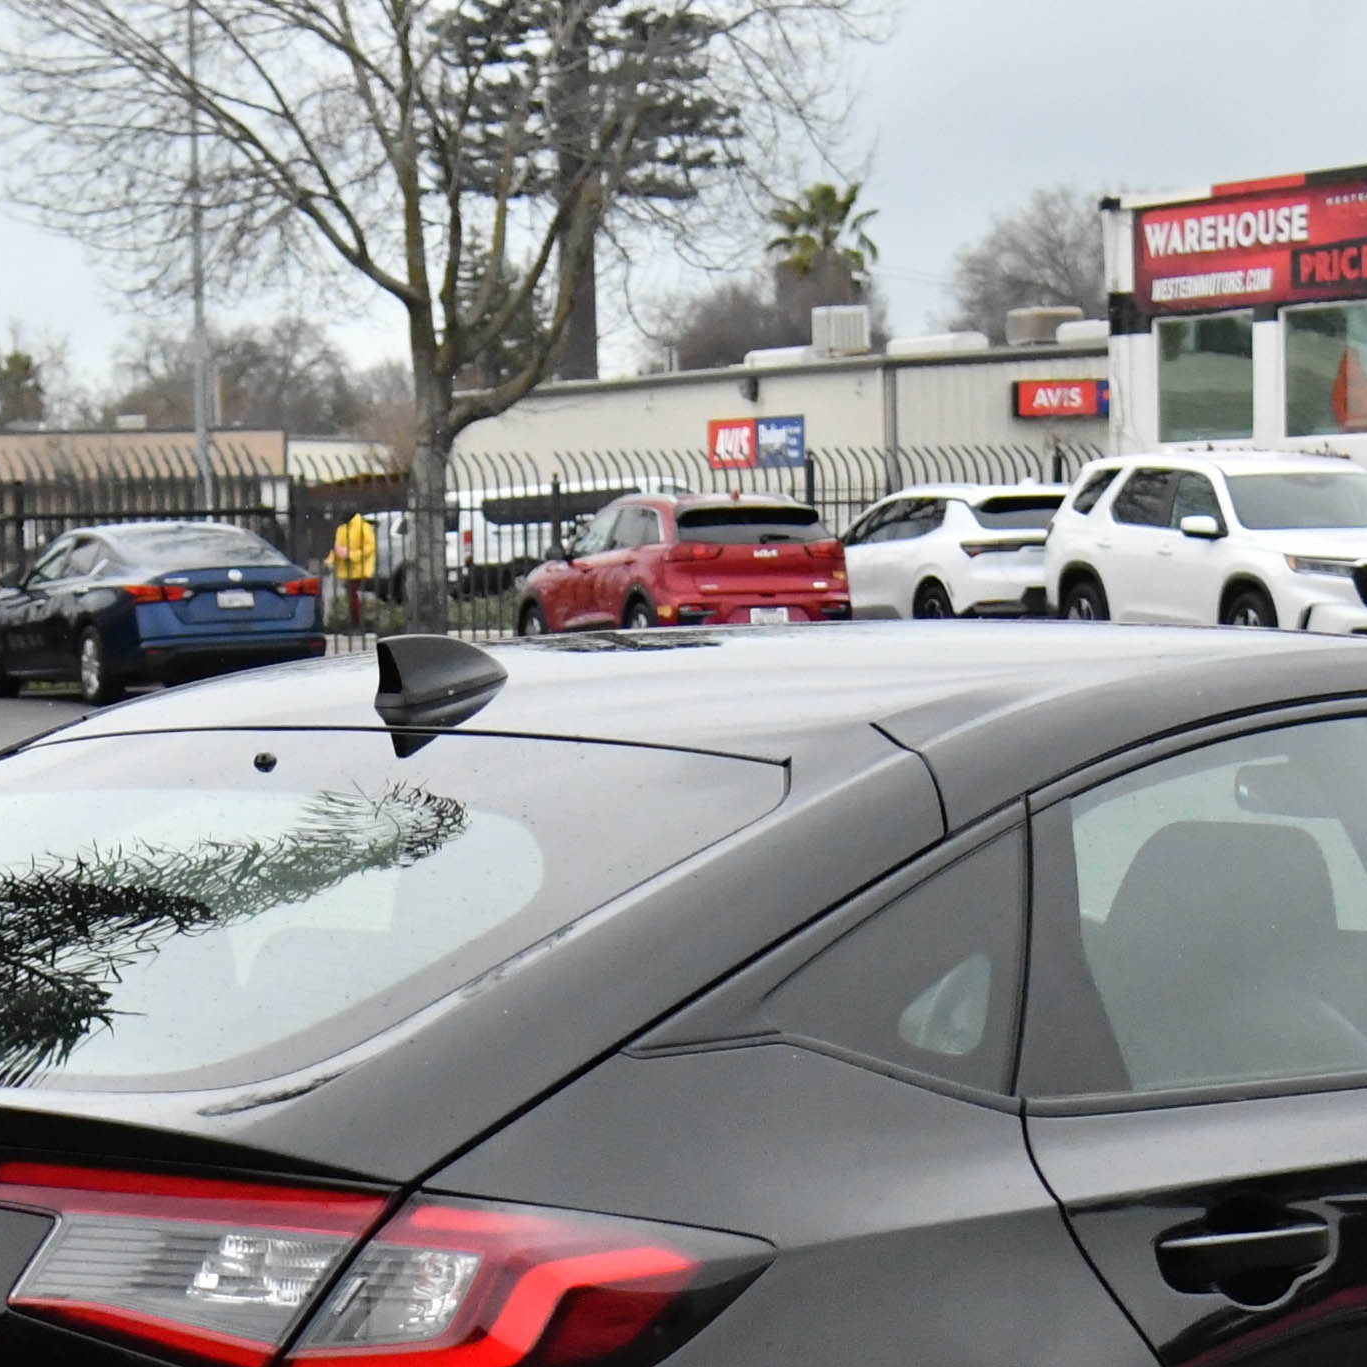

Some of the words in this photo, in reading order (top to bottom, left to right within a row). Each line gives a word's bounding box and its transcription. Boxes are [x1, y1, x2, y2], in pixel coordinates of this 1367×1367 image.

[1144, 204, 1309, 258] WAREHOUSE
[1033, 387, 1082, 408] AVIS
[714, 426, 751, 460] AVIS
